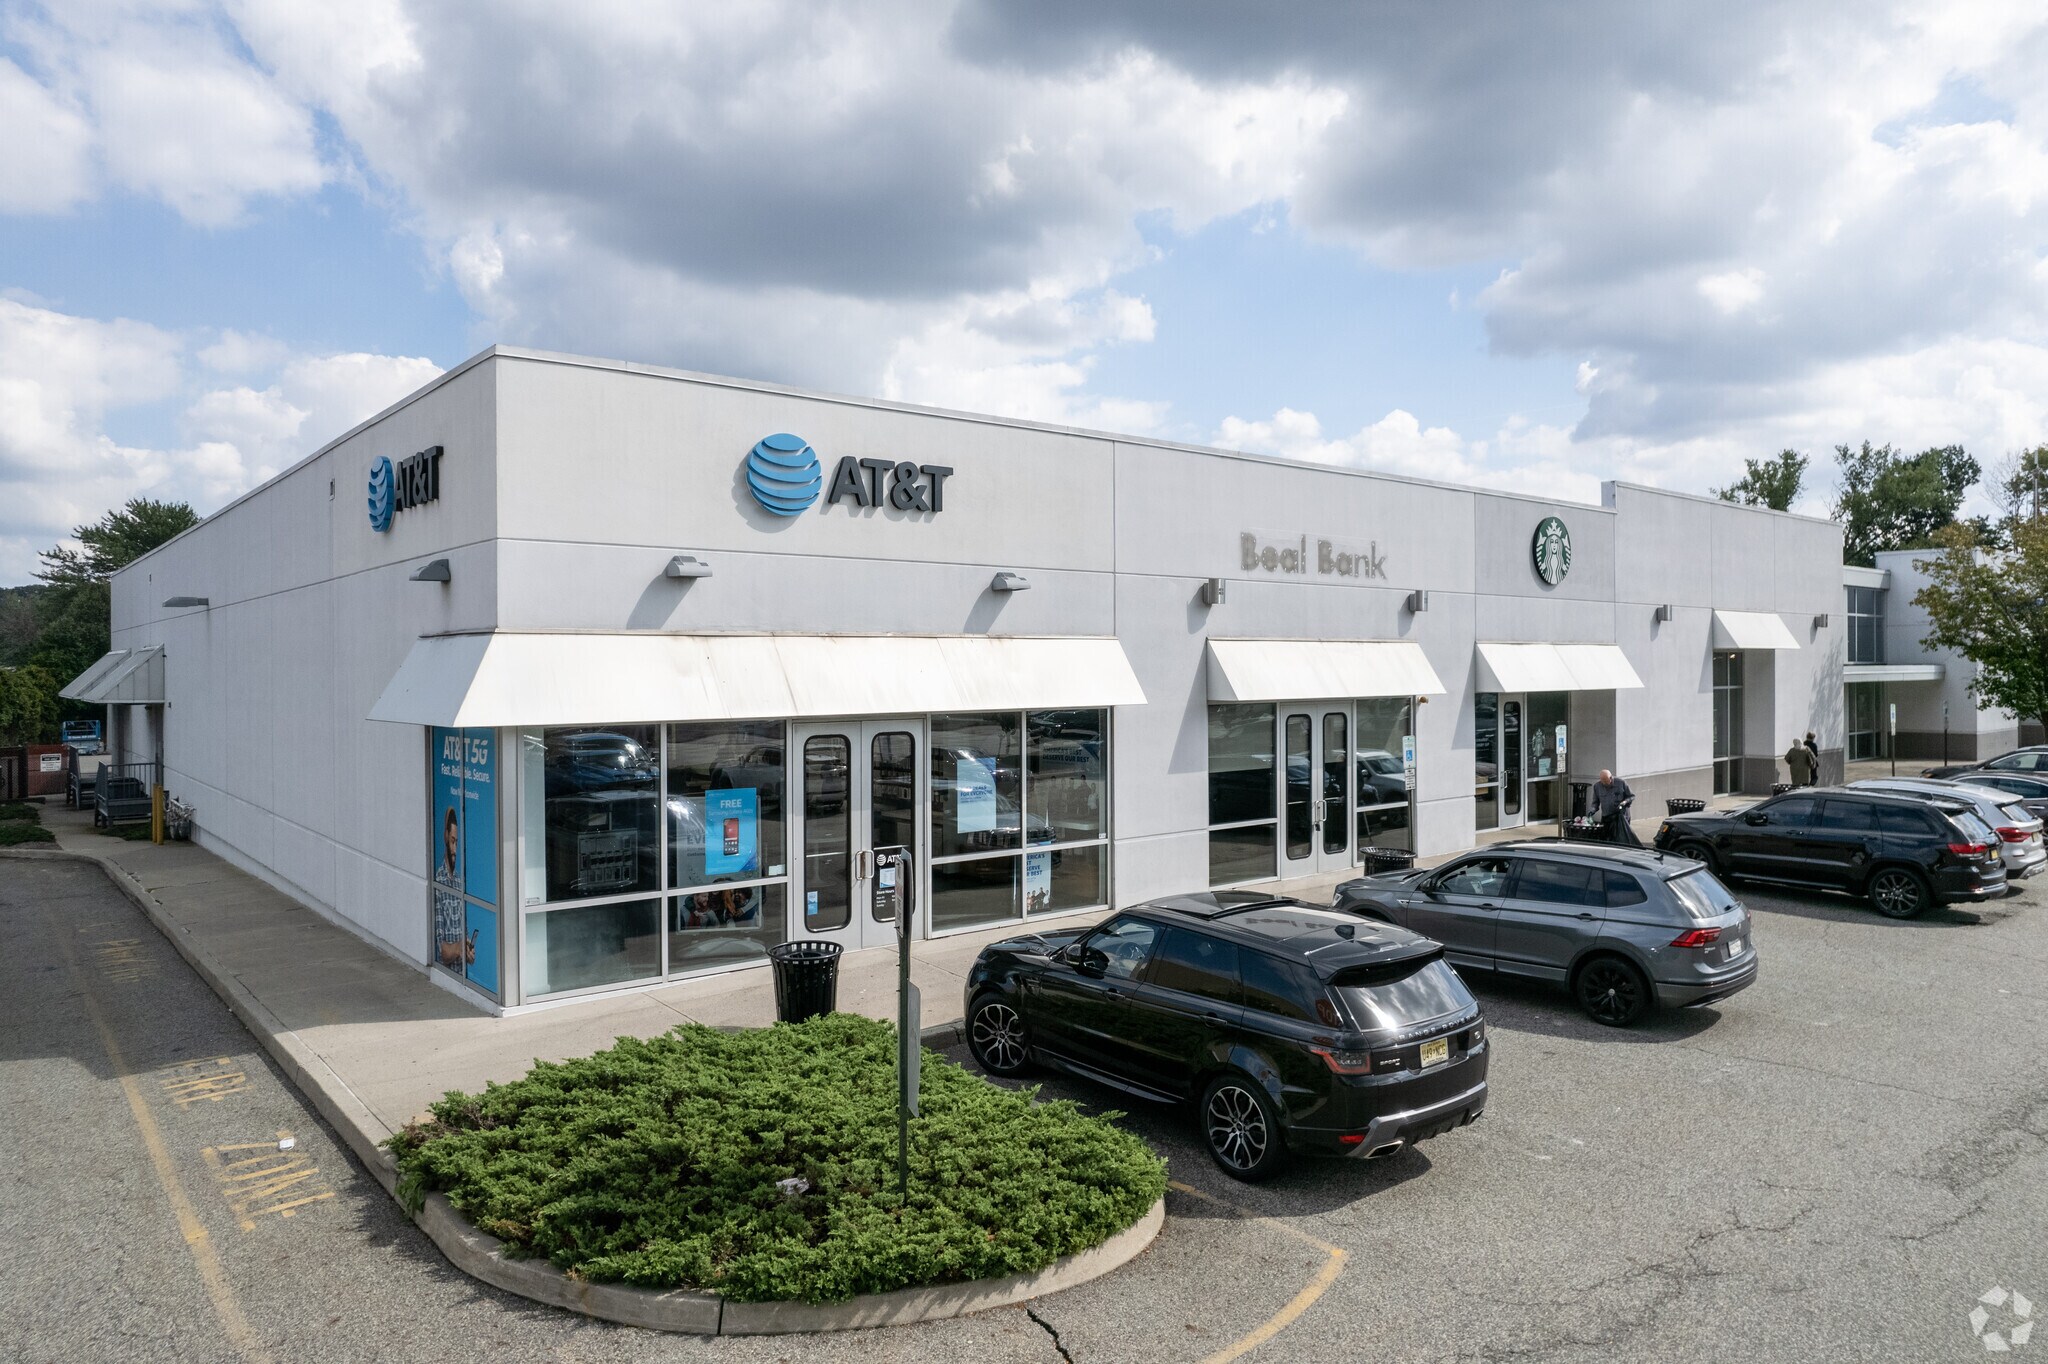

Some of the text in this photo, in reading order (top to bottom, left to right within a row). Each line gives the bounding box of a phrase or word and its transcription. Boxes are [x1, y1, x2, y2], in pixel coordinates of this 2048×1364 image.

[394, 446, 444, 512] AT&T
[828, 455, 954, 512] AT&T
[1318, 540, 1387, 579] Bank
[443, 736, 488, 765] AT&T 5G
[720, 799, 742, 809] FREE
[1399, 1015, 1472, 1039] RANGE ROVER
